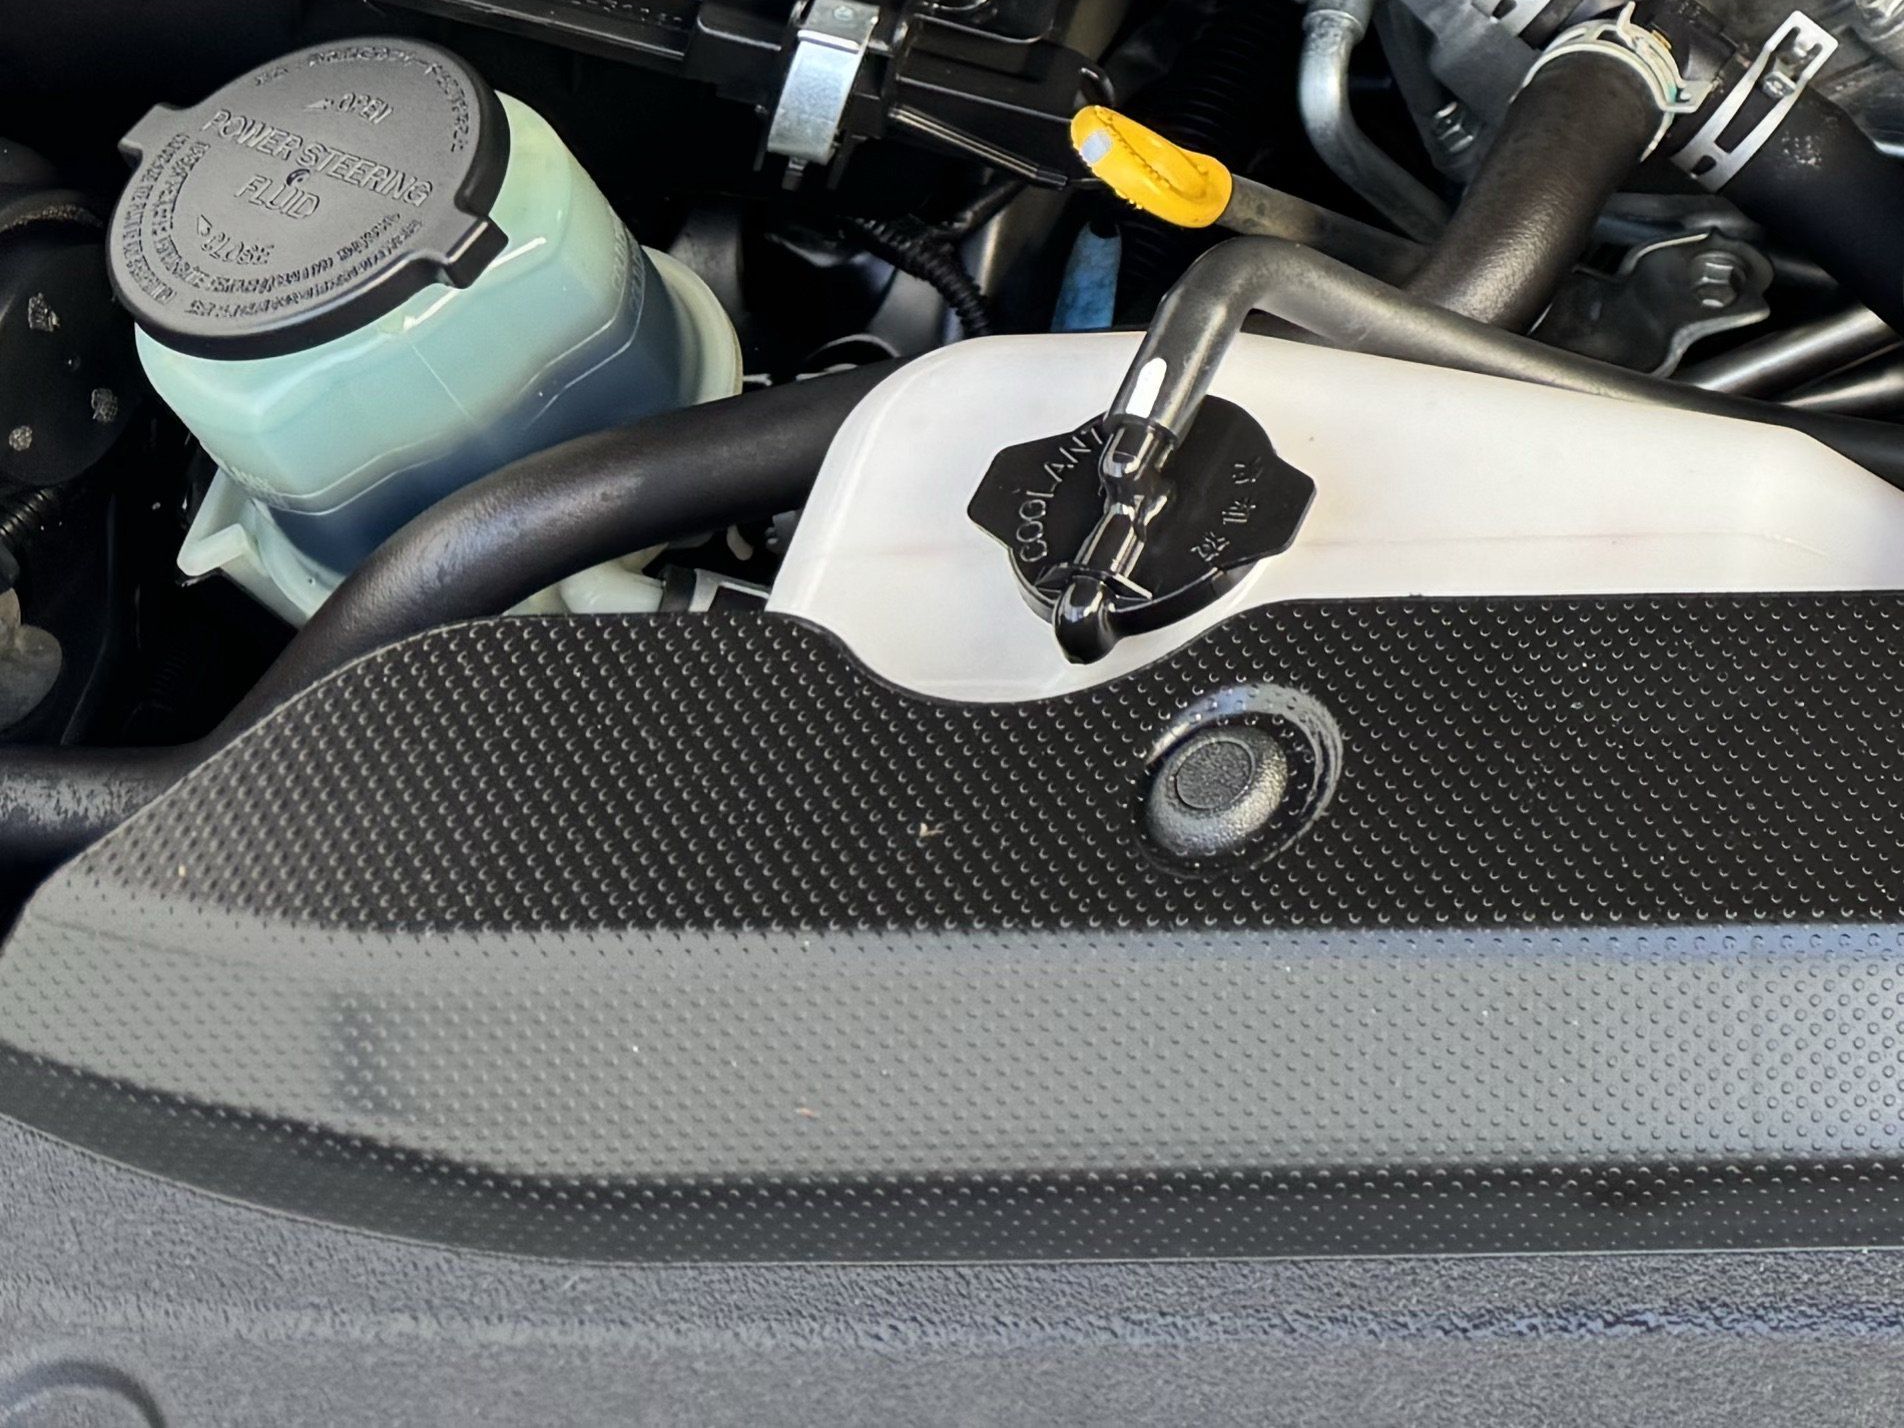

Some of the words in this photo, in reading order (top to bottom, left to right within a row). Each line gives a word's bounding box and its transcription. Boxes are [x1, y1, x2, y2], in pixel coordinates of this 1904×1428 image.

[337, 91, 394, 126] OPEN
[202, 108, 301, 161] POWER
[296, 141, 435, 208] STEERING
[233, 174, 321, 220] FLUID
[206, 225, 276, 266] CLOSE
